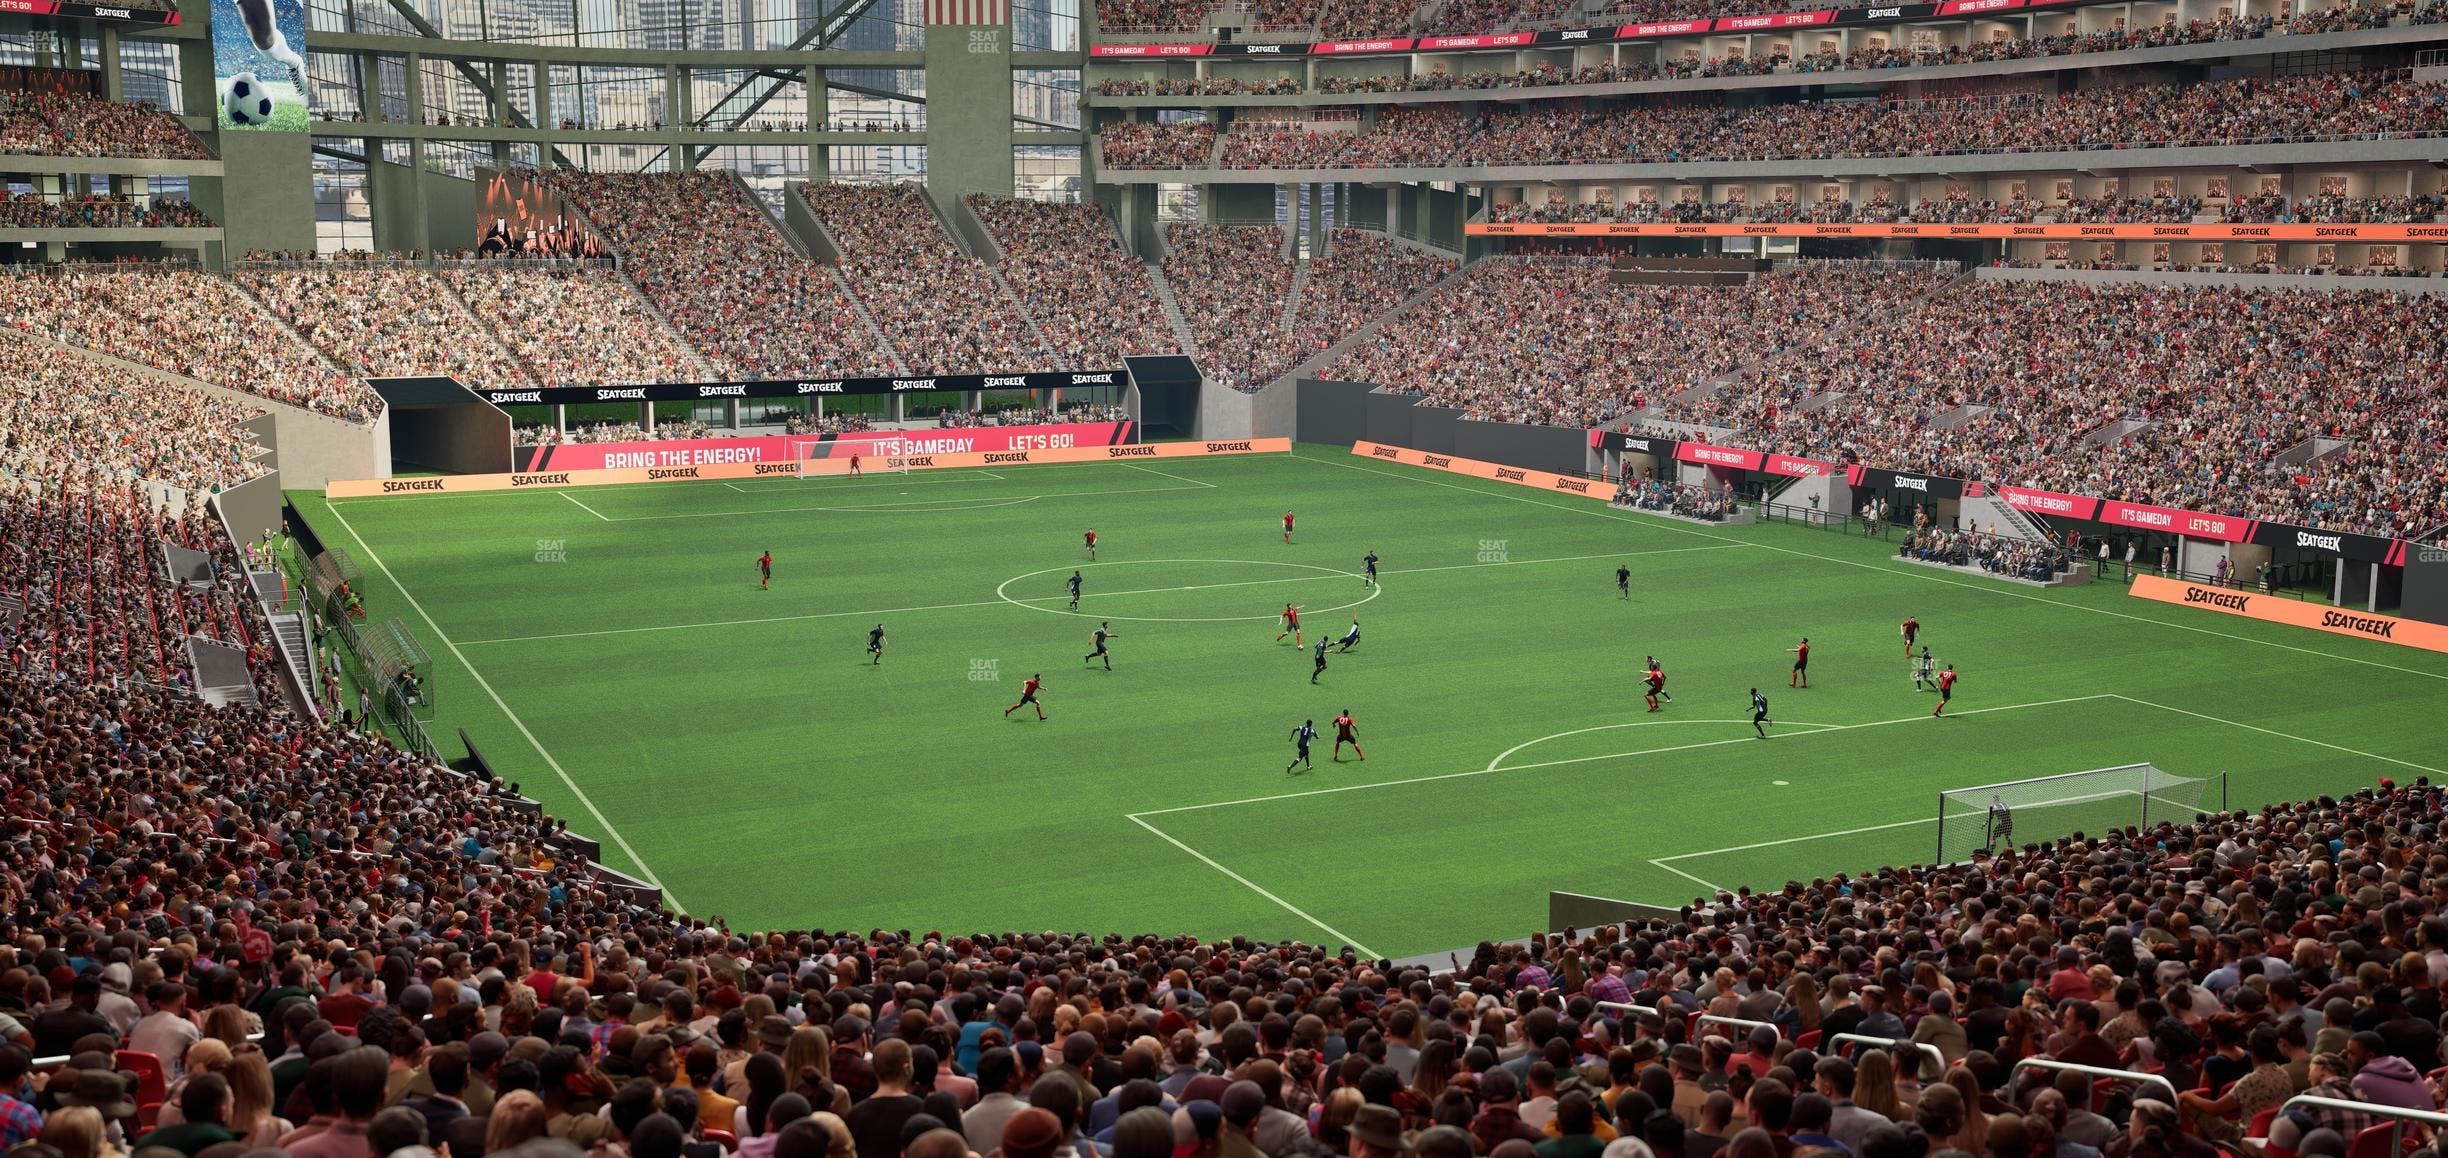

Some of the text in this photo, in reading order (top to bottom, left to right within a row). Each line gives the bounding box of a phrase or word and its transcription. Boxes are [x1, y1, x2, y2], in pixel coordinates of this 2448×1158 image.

[0, 0, 17, 8] ET'S
[1960, 2, 1975, 10] BRING
[95, 8, 130, 18] SEATGEEK
[1868, 7, 1900, 18] SEATGEEK
[1744, 18, 1771, 26] GAMEDAY
[1668, 24, 1691, 32] ENERGY!
[1562, 30, 1588, 39] SEATGEEK
[2013, 227, 2045, 235] SEATGEEK
[2081, 227, 2114, 235] SEATGEEK
[2154, 228, 2189, 236] SEATGEEK
[2232, 228, 2270, 236] SEATGEEK
[2316, 228, 2357, 236] SEATGEEK
[893, 379, 935, 390] SEATGEEK
[984, 376, 1025, 387] SEATGEEK
[1072, 374, 1112, 384] SEATGEEK
[700, 385, 746, 396] SEATGEEK
[798, 382, 842, 393] SEATGEEK
[492, 392, 541, 403] SEATGEEK
[598, 388, 645, 399] SEATGEEK
[1010, 434, 1073, 450] LET'S GO!
[1207, 442, 1251, 453] SEATGEEK
[1626, 438, 1650, 452] SEATGEEK
[874, 438, 973, 458] IT'S GAMEDAY
[1109, 446, 1156, 457] SEATGEEK
[1373, 446, 1399, 460] SEATGEEK
[606, 448, 760, 468] BRING THE ENERGY!
[984, 452, 1028, 463] SEATGEEK
[1695, 449, 1743, 463] BRING THE ENERGY!
[1423, 455, 1451, 469] SEATGEEK
[1782, 461, 1792, 471] IT'S
[649, 467, 699, 479] SEATGEEK
[1495, 467, 1526, 482] SEATGEEK
[512, 473, 570, 486] SEATGEEK
[1895, 476, 1927, 492] SEATGEEK
[383, 479, 444, 492] SEATGEEK
[1556, 478, 1589, 494] SEATGEEK
[2030, 495, 2043, 508] THE
[2044, 498, 2073, 512] ENERGY!
[2122, 509, 2171, 526] IT'S GAMEDAY
[2189, 519, 2225, 533] LET'S GO!
[2297, 532, 2341, 552] SEATGEEK
[2185, 587, 2250, 612] SEATGEEK
[2321, 611, 2397, 638] SEATGEEK
